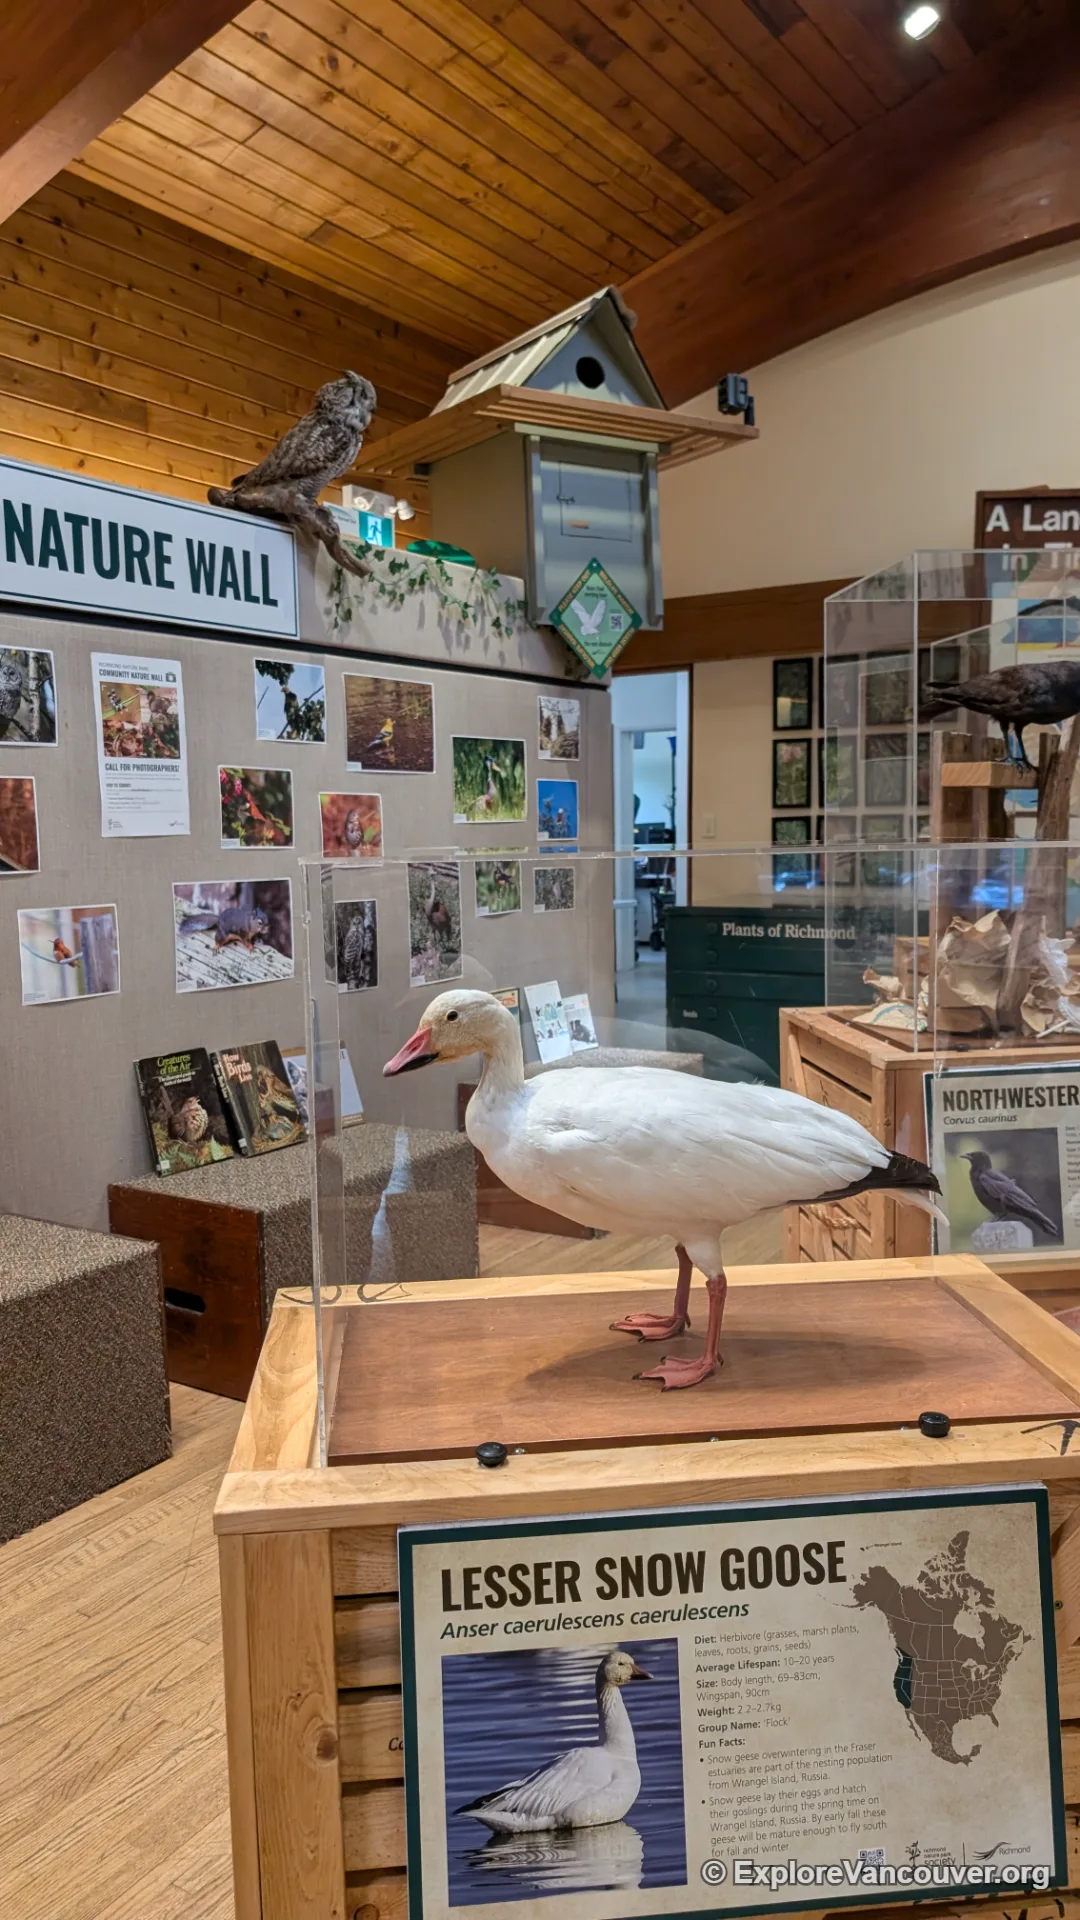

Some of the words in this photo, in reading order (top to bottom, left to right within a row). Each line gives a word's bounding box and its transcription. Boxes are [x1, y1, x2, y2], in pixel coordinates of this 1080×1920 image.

[985, 504, 1010, 532] A
[1022, 504, 1080, 532] Lan
[3, 499, 175, 590] NATURE
[185, 537, 279, 607] WALL
[1002, 543, 1028, 571] in
[99, 669, 129, 679] COMMUNITY
[131, 671, 149, 680] NATURE
[151, 673, 164, 682] WALL
[105, 763, 119, 771] CALL
[120, 763, 131, 772] FOR
[132, 763, 180, 773] PHOTOGRAPHERS!
[722, 922, 765, 937] Plants
[767, 923, 782, 938] of
[784, 924, 856, 940] Richmond
[157, 1054, 191, 1067] Creatures
[222, 1053, 239, 1064] How
[160, 1066, 167, 1075] of
[168, 1065, 178, 1073] the
[179, 1062, 191, 1070] Air
[226, 1060, 252, 1078] Birds
[943, 1085, 1080, 1112] NORTHWESTER
[943, 1116, 976, 1125] Corvus
[978, 1113, 1018, 1124] caurinus
[441, 1560, 581, 1612] LESSER
[595, 1550, 706, 1601] SNOW
[720, 1540, 847, 1591] GOOSE
[440, 1620, 500, 1640] Anser
[503, 1610, 625, 1636] caerulescens
[630, 1601, 750, 1627] caerulescens
[694, 1635, 717, 1645] Diet:
[720, 1633, 761, 1643] Herbivore
[764, 1630, 800, 1641] (grasses,
[802, 1626, 829, 1637] marsh
[831, 1624, 859, 1636] plants,
[694, 1648, 723, 1658] leaves,
[726, 1646, 750, 1655] roots,
[753, 1643, 782, 1655] grains,
[784, 1640, 811, 1651] seeds)
[696, 1663, 735, 1673] Average
[738, 1659, 780, 1671] Lifespan:
[812, 1655, 835, 1666] years
[696, 1679, 718, 1689] Size:
[721, 1677, 742, 1688] Body
[745, 1675, 775, 1686] length,
[696, 1690, 743, 1702] Wingspan,
[745, 1688, 770, 1698] 90cm
[697, 1707, 735, 1718] Weight:
[698, 1723, 728, 1733] Group
[731, 1721, 761, 1730] Name:
[699, 1740, 716, 1749] Fun
[719, 1737, 746, 1747] Facts:
[707, 1755, 731, 1764] Snow
[734, 1752, 760, 1764] geese
[762, 1747, 822, 1760] overwintering
[824, 1745, 832, 1754] in
[834, 1743, 848, 1753] the
[850, 1742, 876, 1752] Fraser
[708, 1766, 746, 1777] estuaries
[748, 1765, 762, 1773] are
[764, 1763, 782, 1775] part
[785, 1761, 794, 1771] of
[796, 1760, 811, 1770] the
[813, 1756, 844, 1769] nesting
[847, 1753, 892, 1766] population
[709, 1780, 730, 1790] from
[732, 1775, 768, 1788] Wrangel
[771, 1774, 799, 1785] Island,
[801, 1771, 831, 1781] Russia.
[709, 1796, 733, 1806] Snow
[736, 1794, 761, 1805] geese
[764, 1791, 776, 1802] lay
[778, 1789, 798, 1799] their
[800, 1788, 821, 1799] eggs
[823, 1786, 840, 1796] and
[842, 1784, 867, 1793] hatch
[710, 1809, 729, 1819] their
[732, 1806, 768, 1818] goslings
[770, 1802, 798, 1815] during
[801, 1801, 815, 1811] the
[817, 1798, 844, 1810] spring
[846, 1797, 866, 1806] time
[868, 1796, 880, 1804] on
[710, 1821, 747, 1833] Wrangel
[750, 1818, 777, 1829] Island,
[780, 1815, 809, 1825] Russia.
[811, 1813, 822, 1824] By
[824, 1810, 845, 1822] early
[848, 1808, 860, 1818] fall
[863, 1807, 886, 1817] these
[711, 1835, 736, 1846] geese
[738, 1831, 753, 1841] will
[755, 1830, 767, 1840] be
[770, 1827, 800, 1838] mature
[803, 1825, 836, 1837] enough
[838, 1824, 848, 1833] to
[850, 1822, 861, 1834] fly
[863, 1820, 887, 1831] south
[711, 1847, 724, 1858] for
[726, 1845, 739, 1856] fall
[742, 1844, 759, 1855] and
[999, 1845, 1031, 1855] Richmond
[924, 1857, 956, 1866] society
